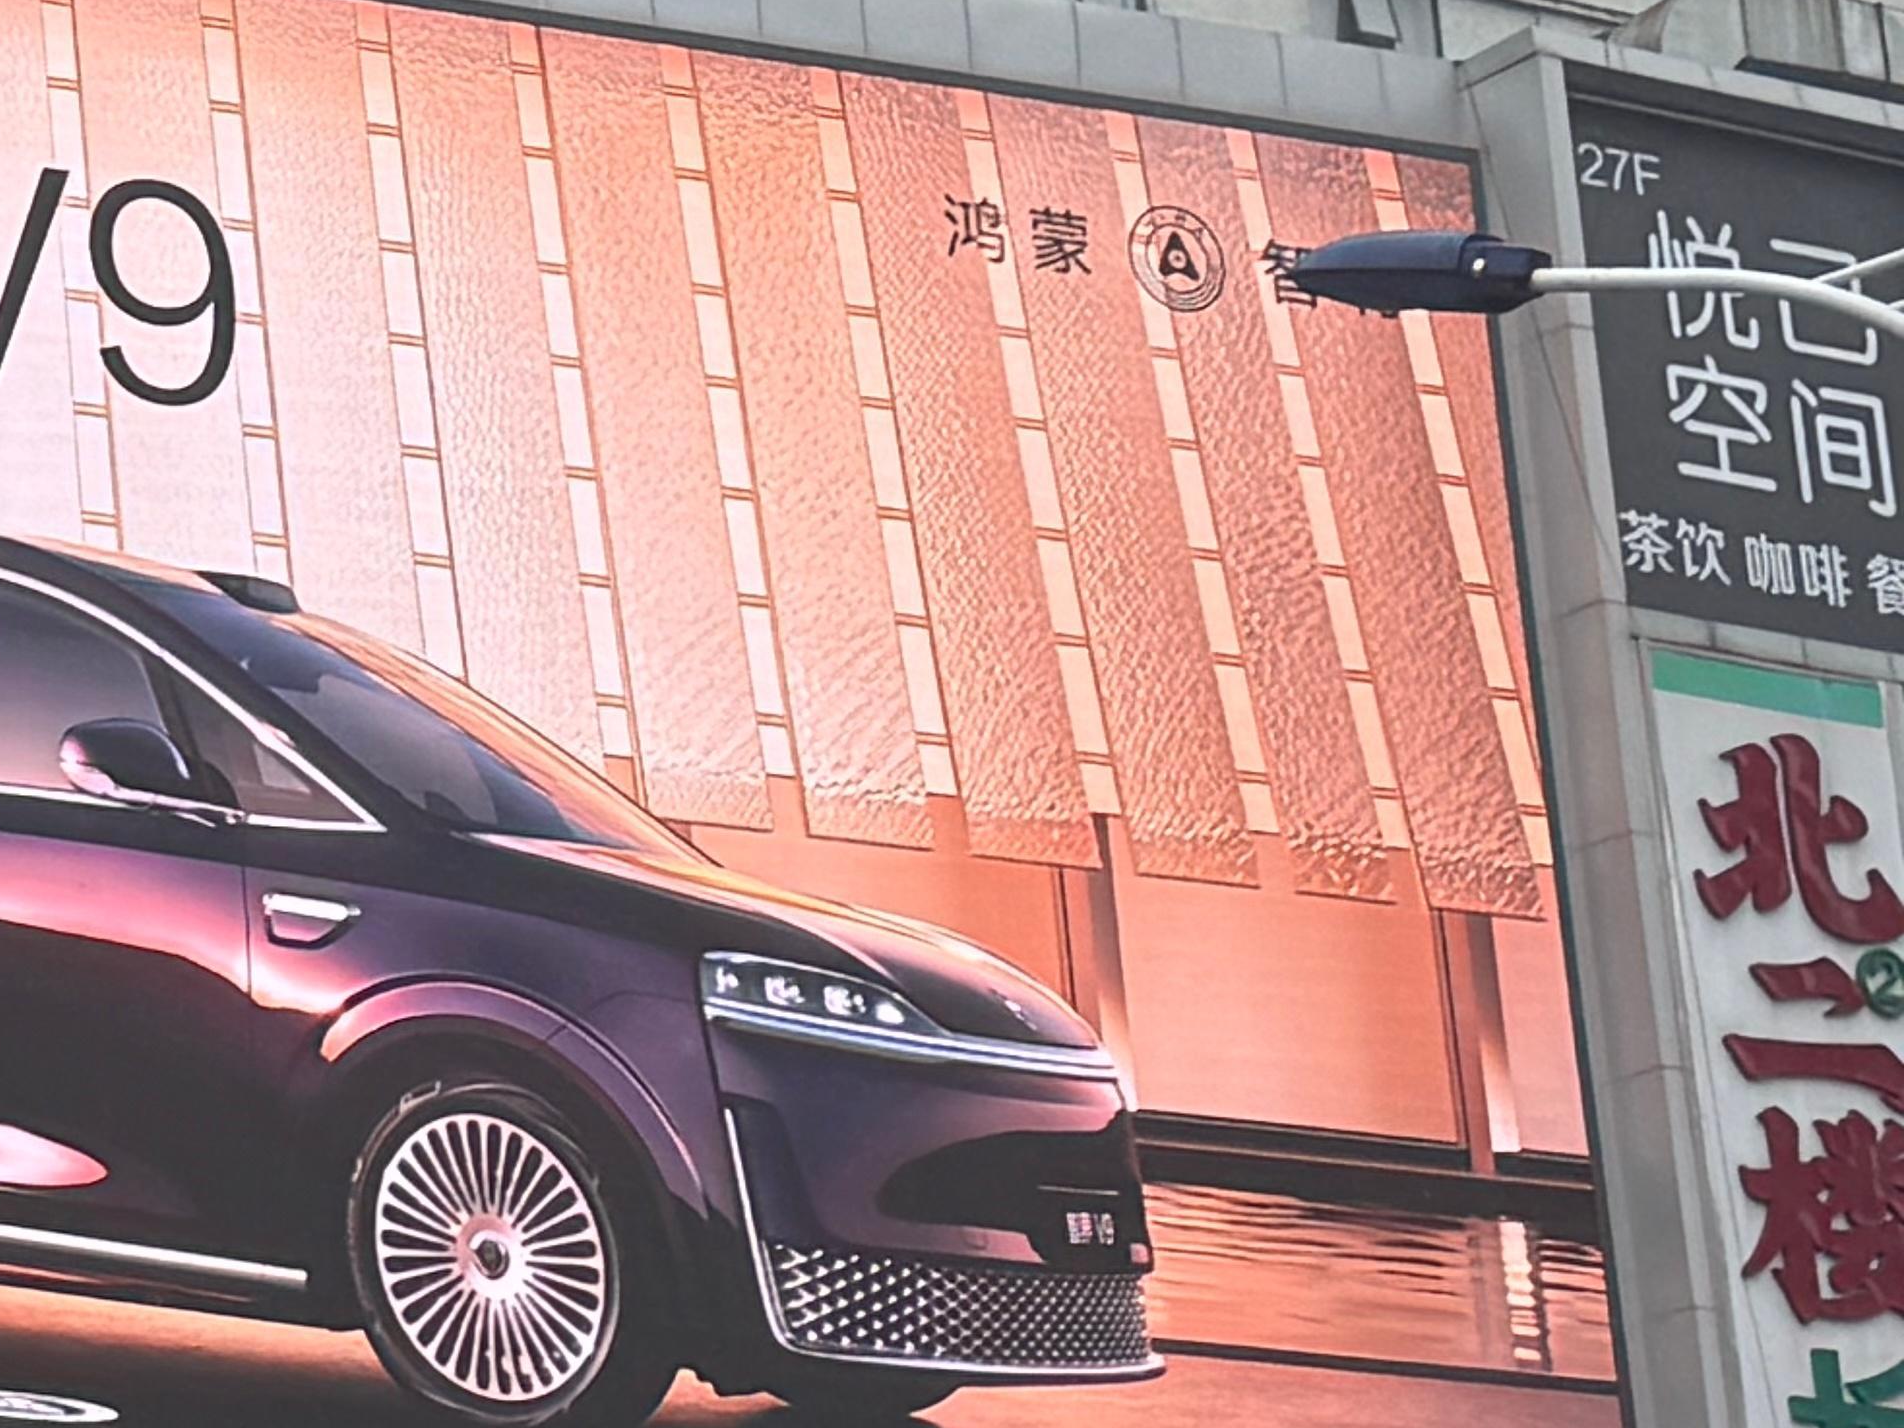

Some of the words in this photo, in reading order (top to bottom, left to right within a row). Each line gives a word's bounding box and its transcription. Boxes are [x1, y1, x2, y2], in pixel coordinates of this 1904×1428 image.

[1577, 142, 1661, 197] 27F
[943, 192, 1093, 276] 鸿蒙
[1664, 354, 1898, 518] 空间
[1618, 508, 1732, 587] 茶饮
[1743, 533, 1853, 609] 咖啡
